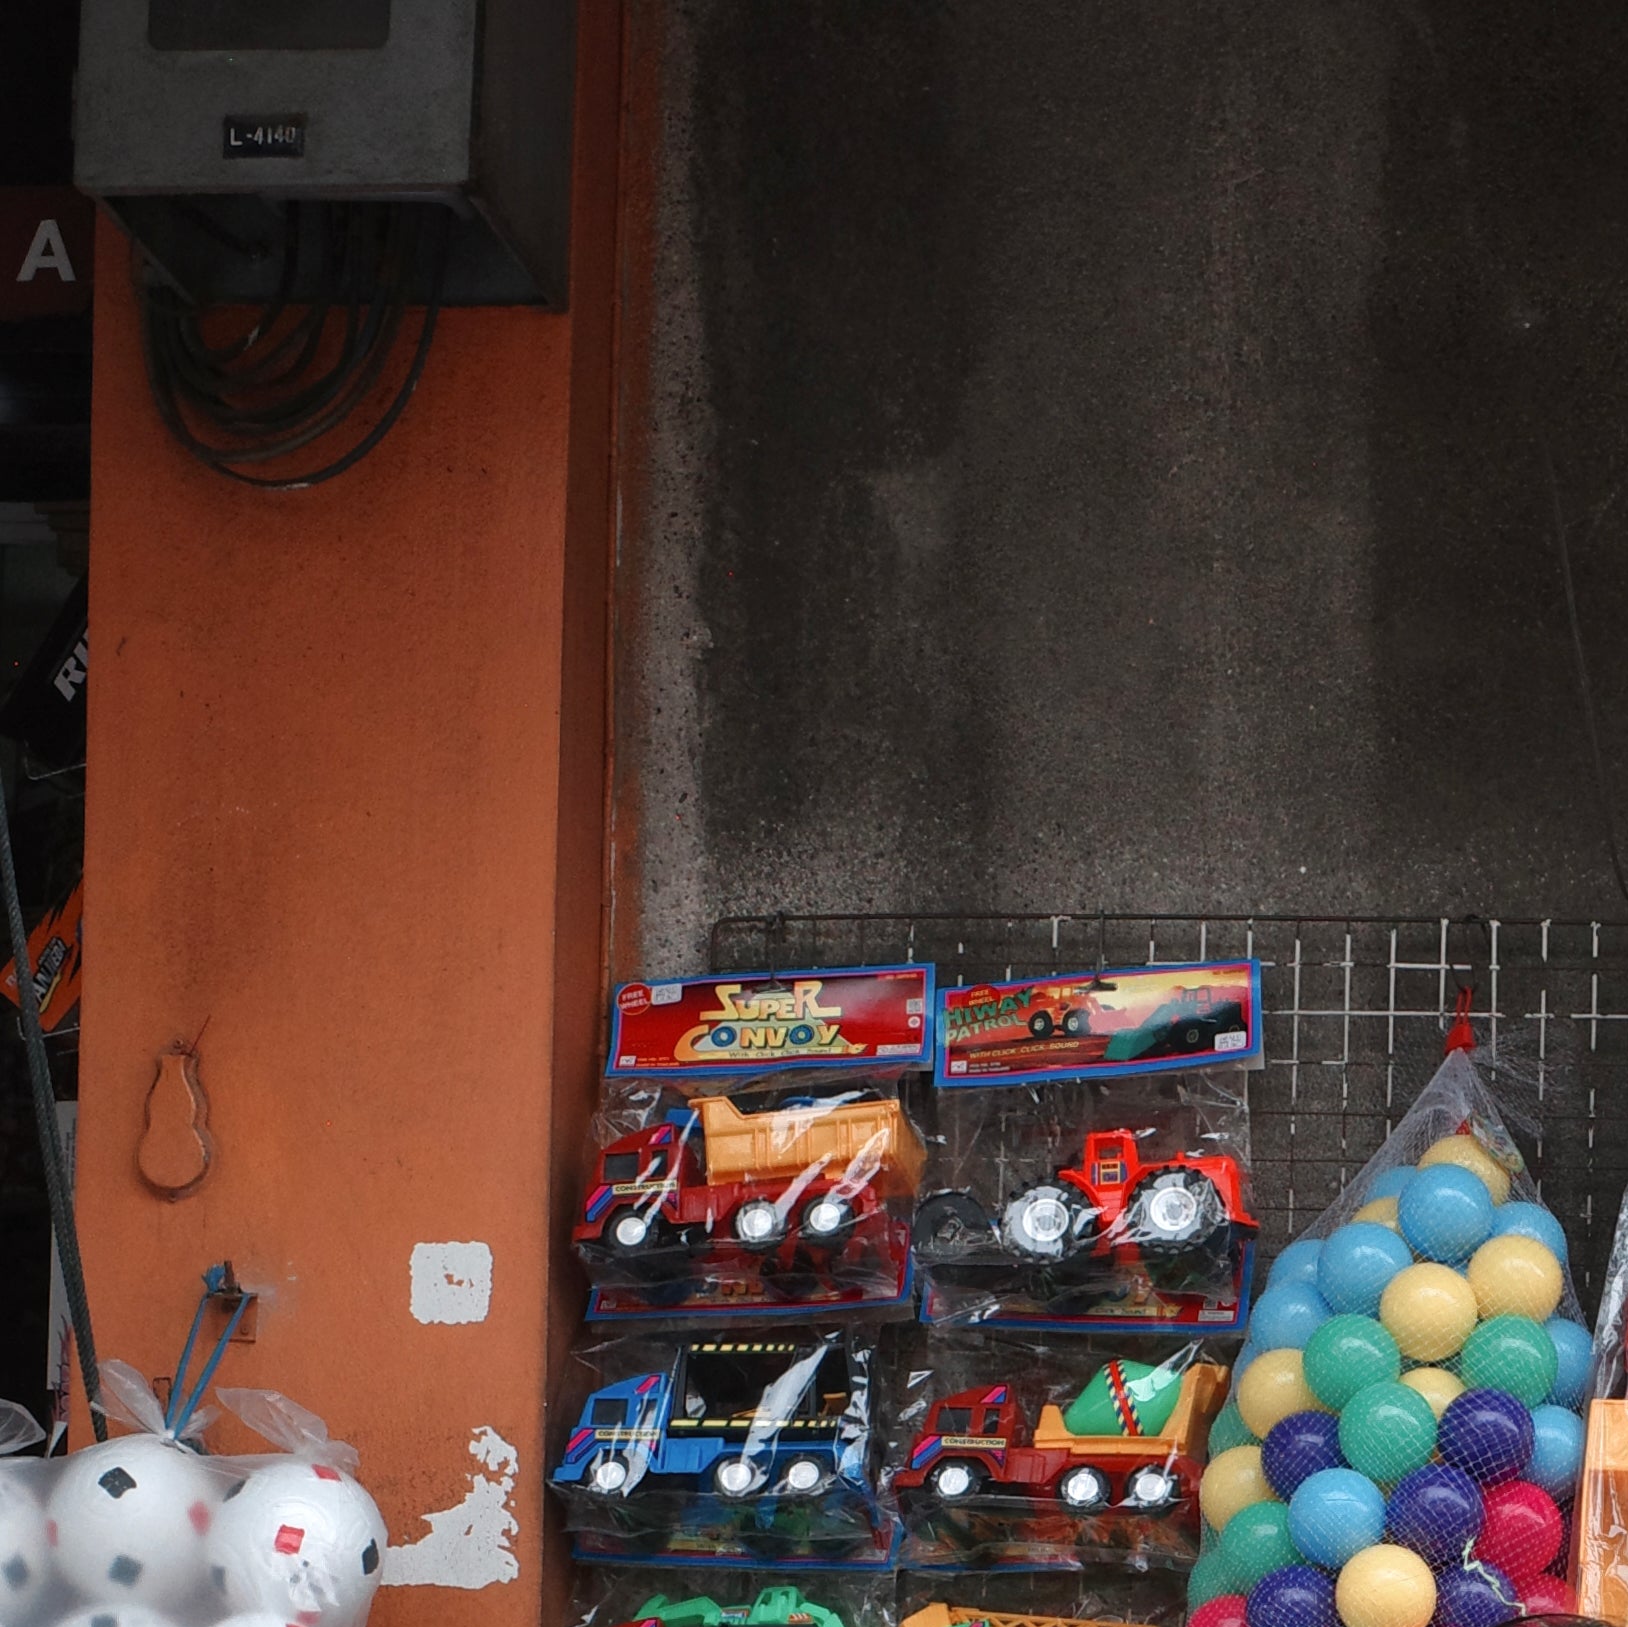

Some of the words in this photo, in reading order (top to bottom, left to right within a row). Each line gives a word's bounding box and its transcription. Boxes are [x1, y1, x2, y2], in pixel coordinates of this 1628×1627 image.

[17, 219, 76, 281] A
[621, 990, 644, 1001] FREE
[700, 980, 841, 1021] SUPER
[943, 987, 1033, 1027] HIWAY
[674, 1024, 840, 1060] CONVOY
[945, 1013, 1030, 1047] PATROL
